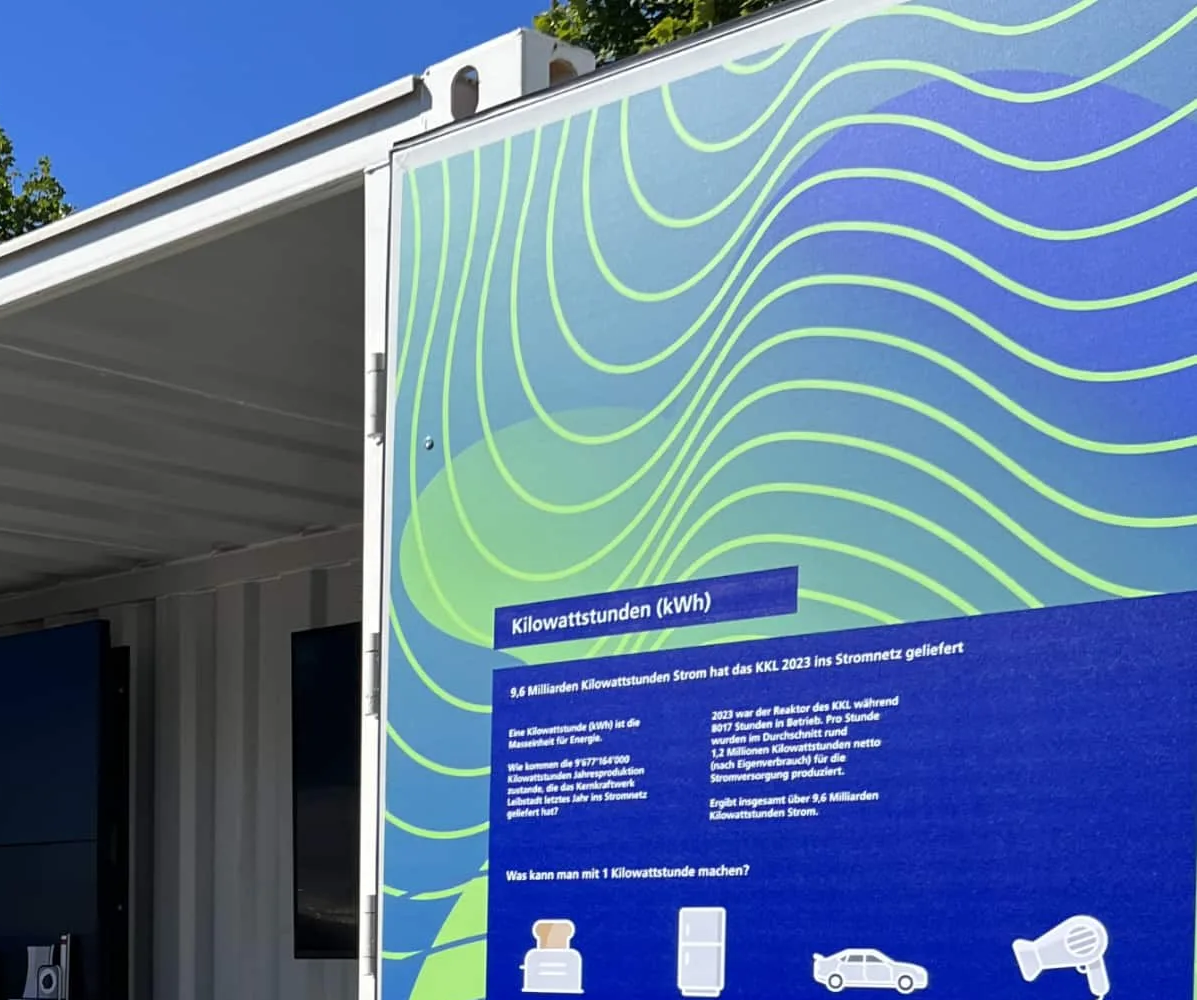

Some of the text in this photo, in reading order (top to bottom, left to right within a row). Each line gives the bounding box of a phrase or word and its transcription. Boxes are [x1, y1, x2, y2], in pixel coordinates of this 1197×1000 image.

[513, 592, 710, 634] Kilowattstunden (kWh)
[511, 642, 963, 698] 9,6 Milliarden Kilowattstunden Strom hat das KKL 2023 ins Stromnetz geliefert
[712, 696, 898, 720] 2023 war der Reaktor des KKL während
[509, 718, 640, 737] Eine Kilowattstunde (kWh) ist die
[735, 720, 773, 731] Stunden
[775, 719, 784, 728] in
[787, 716, 823, 727] Betrieb.
[826, 715, 842, 724] Pro
[845, 711, 880, 723] Stunde
[509, 733, 602, 748] Masseinheit für Energie.
[711, 726, 847, 745] wurden im Durchschnitt rund
[712, 739, 881, 758] 1,2 Millionen Kilowattstunden netto
[508, 763, 523, 771] Wie
[525, 762, 559, 770] kommen
[560, 759, 573, 768] die
[711, 753, 846, 771] (nach Eigenverbrauch) für die
[508, 767, 644, 783] Kilowattstunden Jahresproduktion
[710, 767, 844, 783] Stromversorgung produziert.
[546, 784, 558, 792] die
[560, 783, 574, 791] das
[576, 779, 634, 790] Kernkraftwerk
[507, 791, 647, 806] Leibstadt letztes Jahr ins Stromnetz
[710, 791, 878, 809] Ergibt insgesamt über 9,6 Milliarden
[507, 807, 558, 819] geliefert hat?
[710, 808, 818, 819] Kilowattstunden Strom.
[506, 864, 749, 880] Was kann man mit 1 Kilowattstunde machen?
